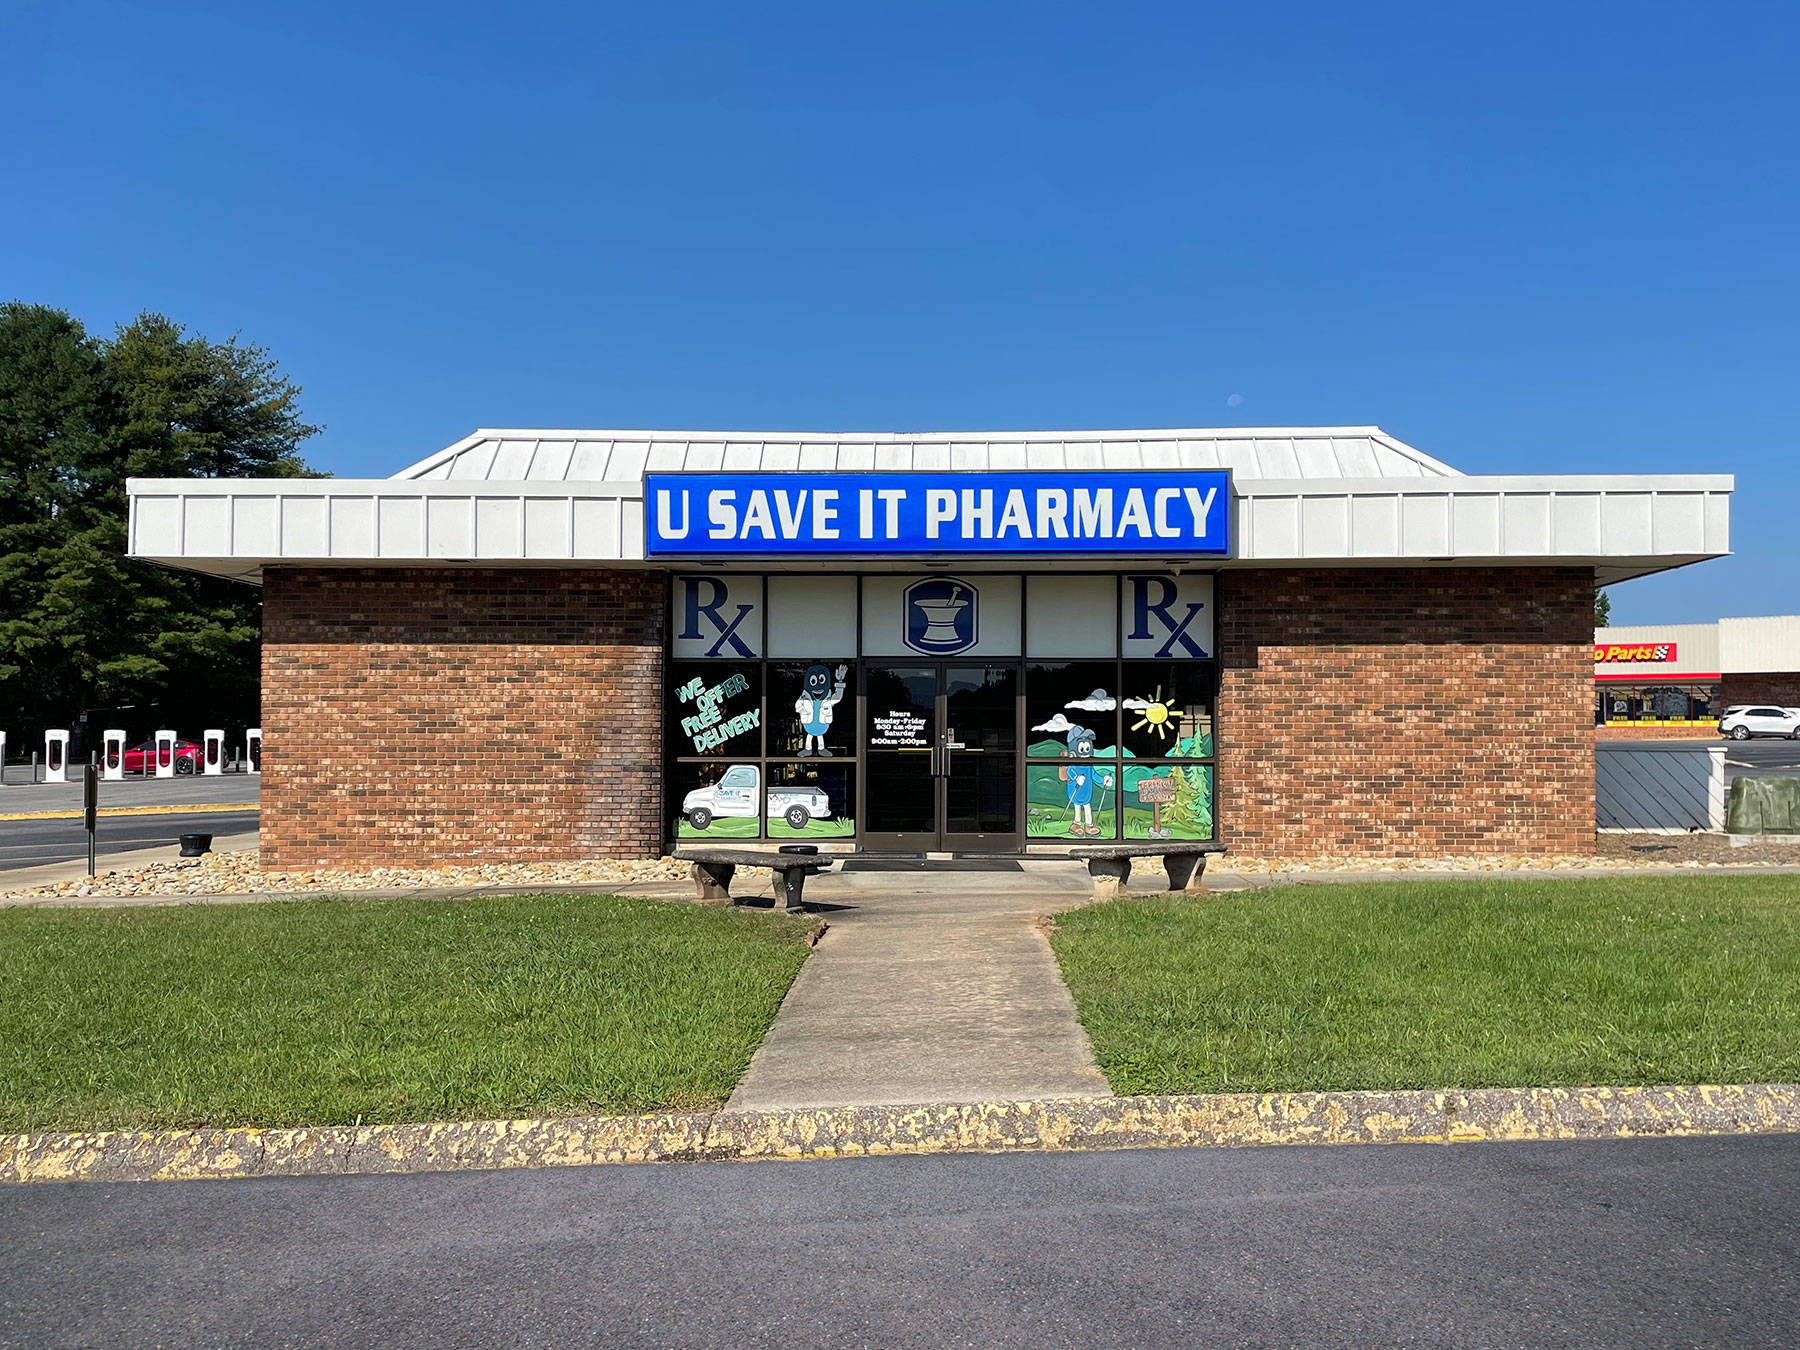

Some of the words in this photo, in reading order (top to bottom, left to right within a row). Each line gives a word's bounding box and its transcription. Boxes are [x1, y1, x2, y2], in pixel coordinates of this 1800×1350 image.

[657, 489, 690, 540] U
[708, 489, 840, 540] SAVE
[859, 488, 907, 539] IT
[925, 487, 1218, 539] PHARMACY
[1606, 645, 1653, 661] Parts
[675, 676, 706, 704] WE
[696, 673, 750, 712] OFFER
[680, 705, 722, 737] FREE
[692, 708, 761, 753] DELIVERY
